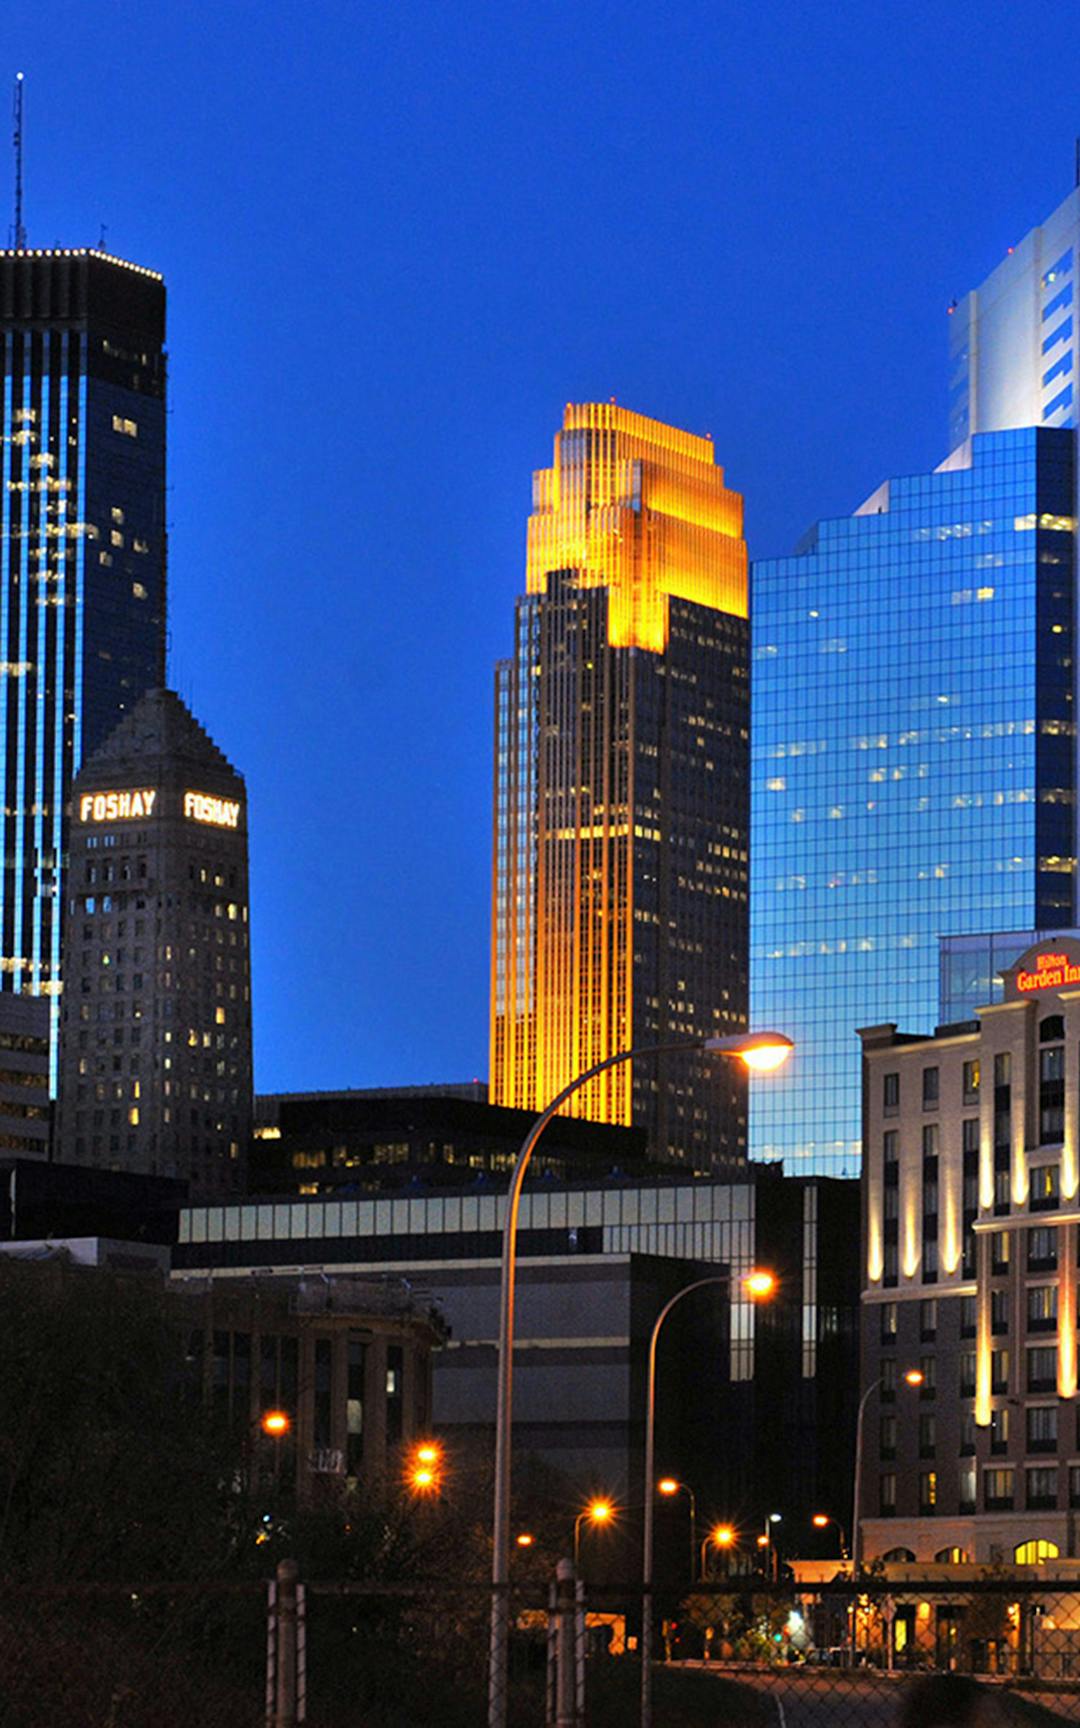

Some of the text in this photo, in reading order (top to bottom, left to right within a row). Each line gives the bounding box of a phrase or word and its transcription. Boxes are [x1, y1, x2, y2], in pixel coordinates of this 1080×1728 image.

[80, 791, 156, 822] FOSHAY
[184, 792, 240, 827] FOSHAY
[1017, 969, 1062, 992] Garden
